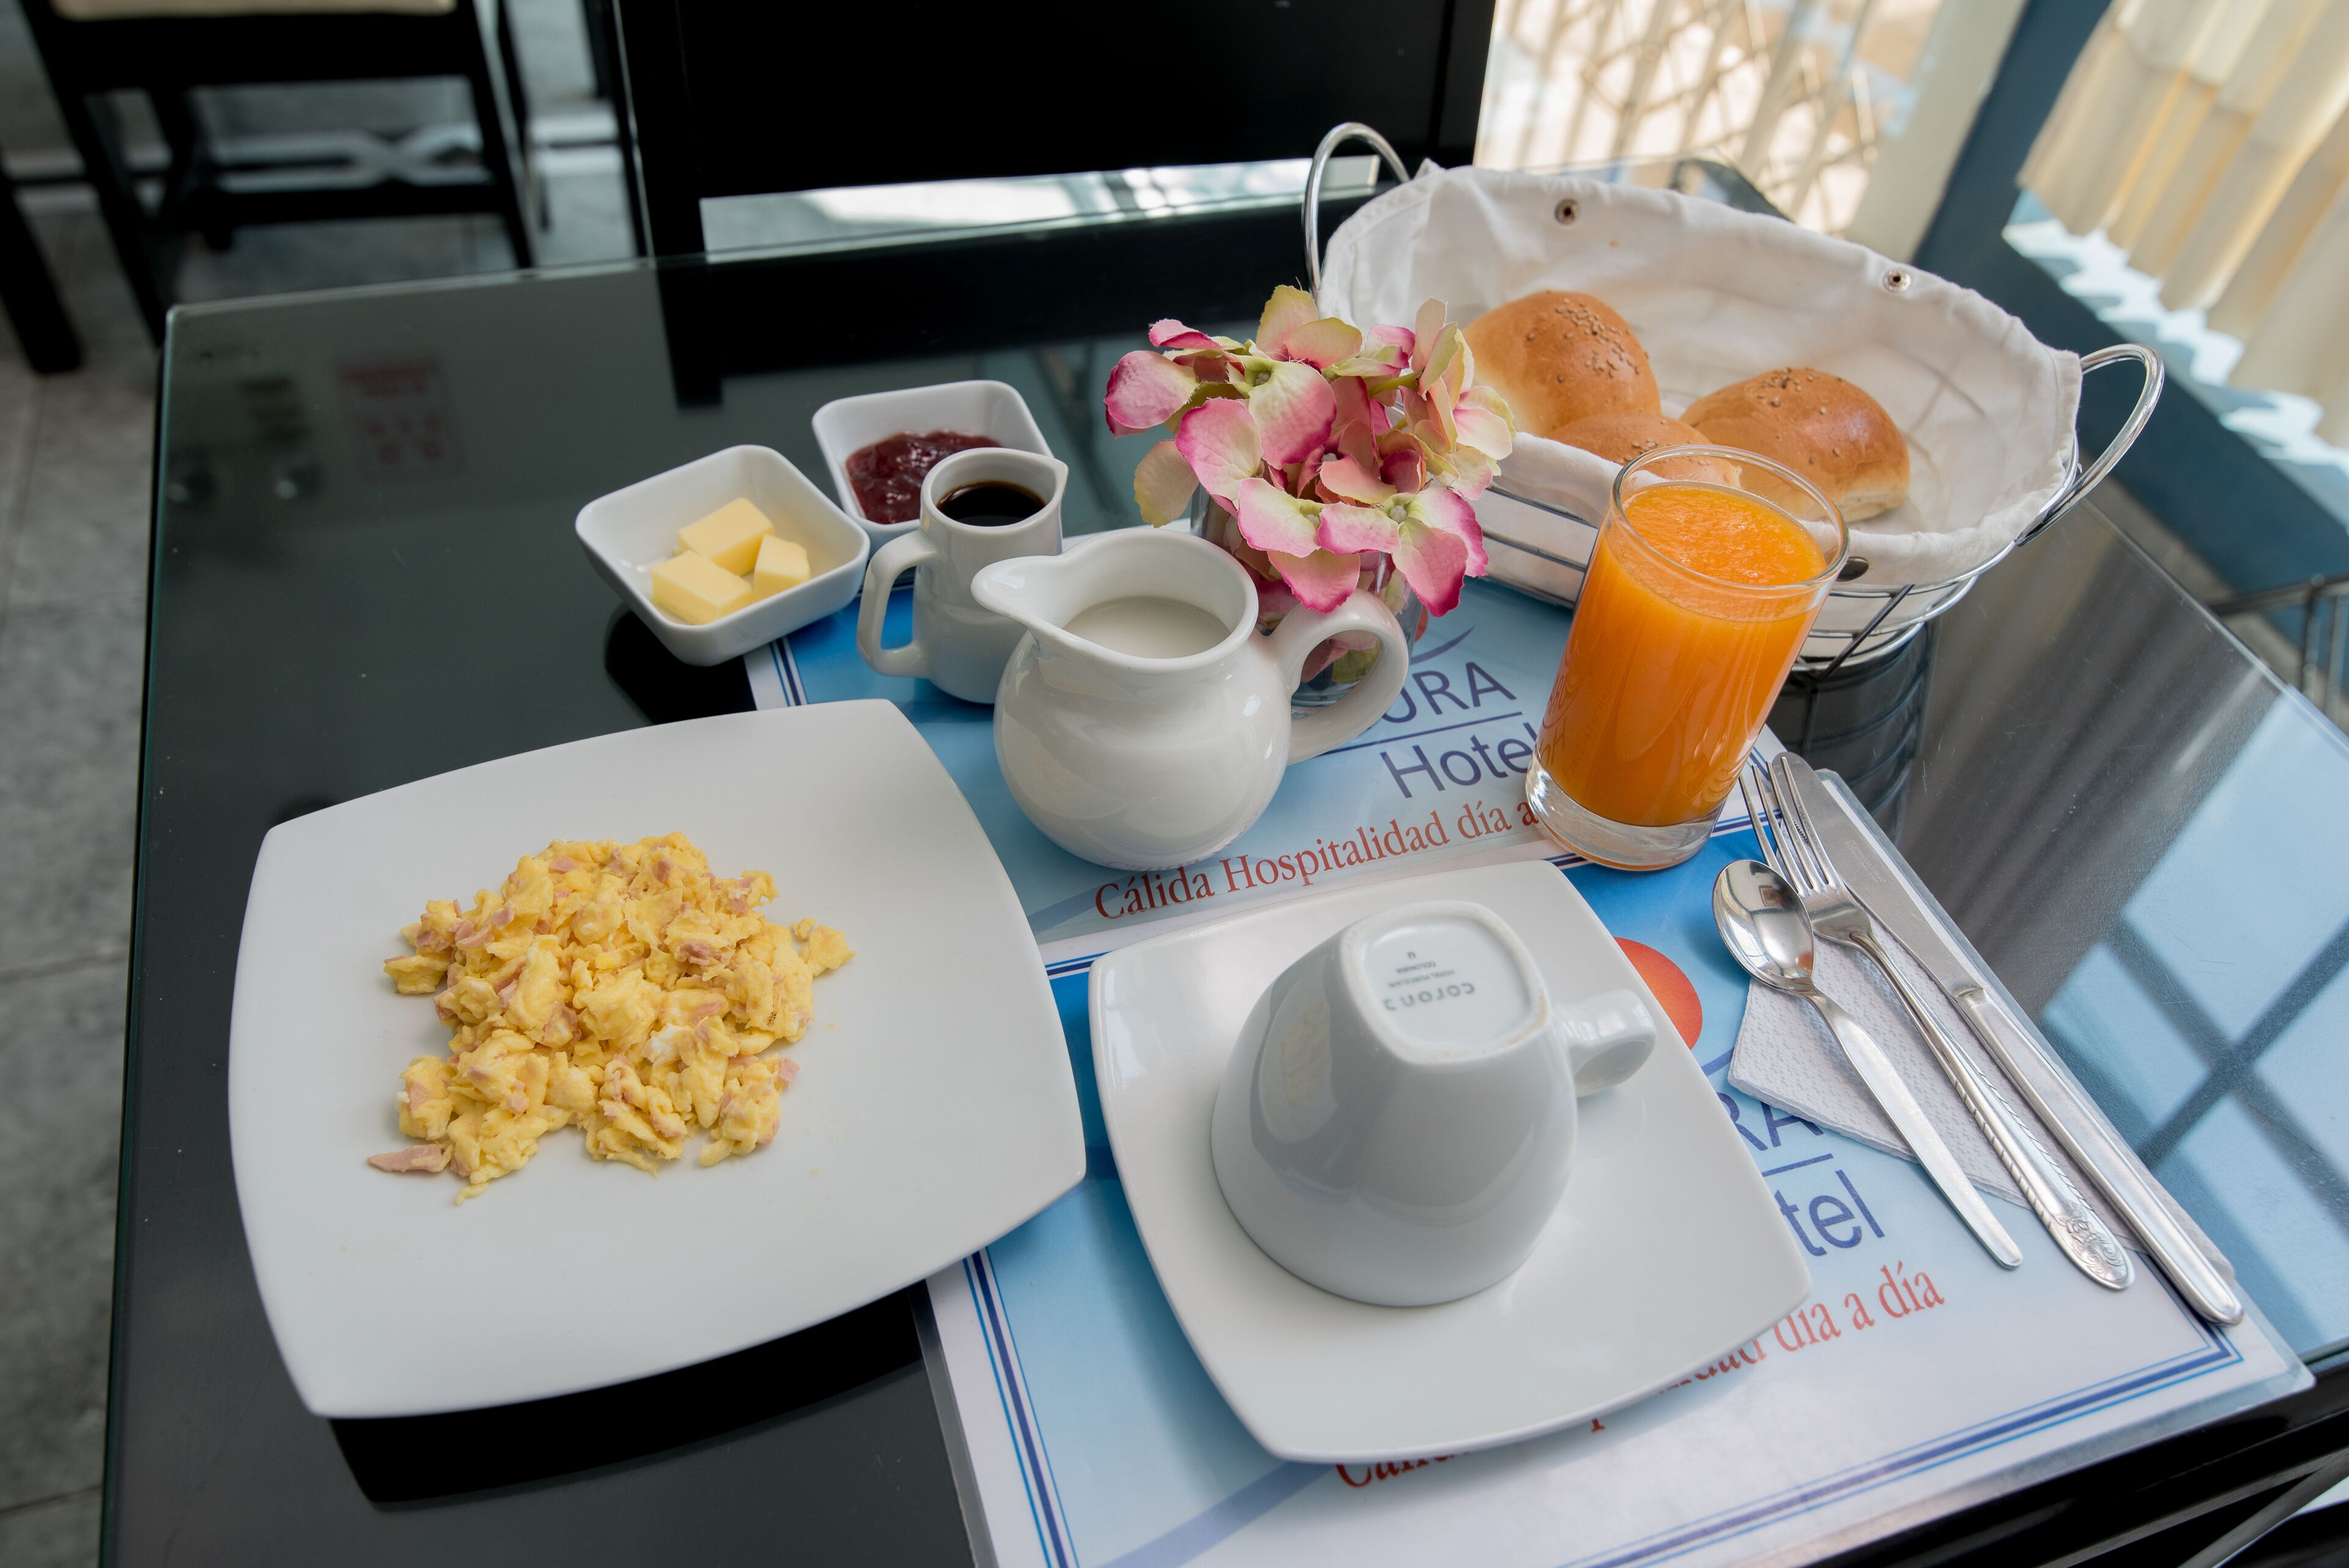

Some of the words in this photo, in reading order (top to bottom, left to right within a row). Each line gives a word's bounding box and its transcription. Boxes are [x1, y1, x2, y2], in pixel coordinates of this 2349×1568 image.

[1381, 661, 1517, 723] URA
[1095, 864, 1215, 919] Cálida
[1219, 810, 1450, 886] Hospitalidad
[1457, 800, 1513, 839] día
[1516, 801, 1538, 826] a
[1716, 1091, 1824, 1151] RA
[1773, 1169, 1885, 1257] tel
[1844, 1291, 1875, 1331] a
[1878, 1260, 1945, 1318] día
